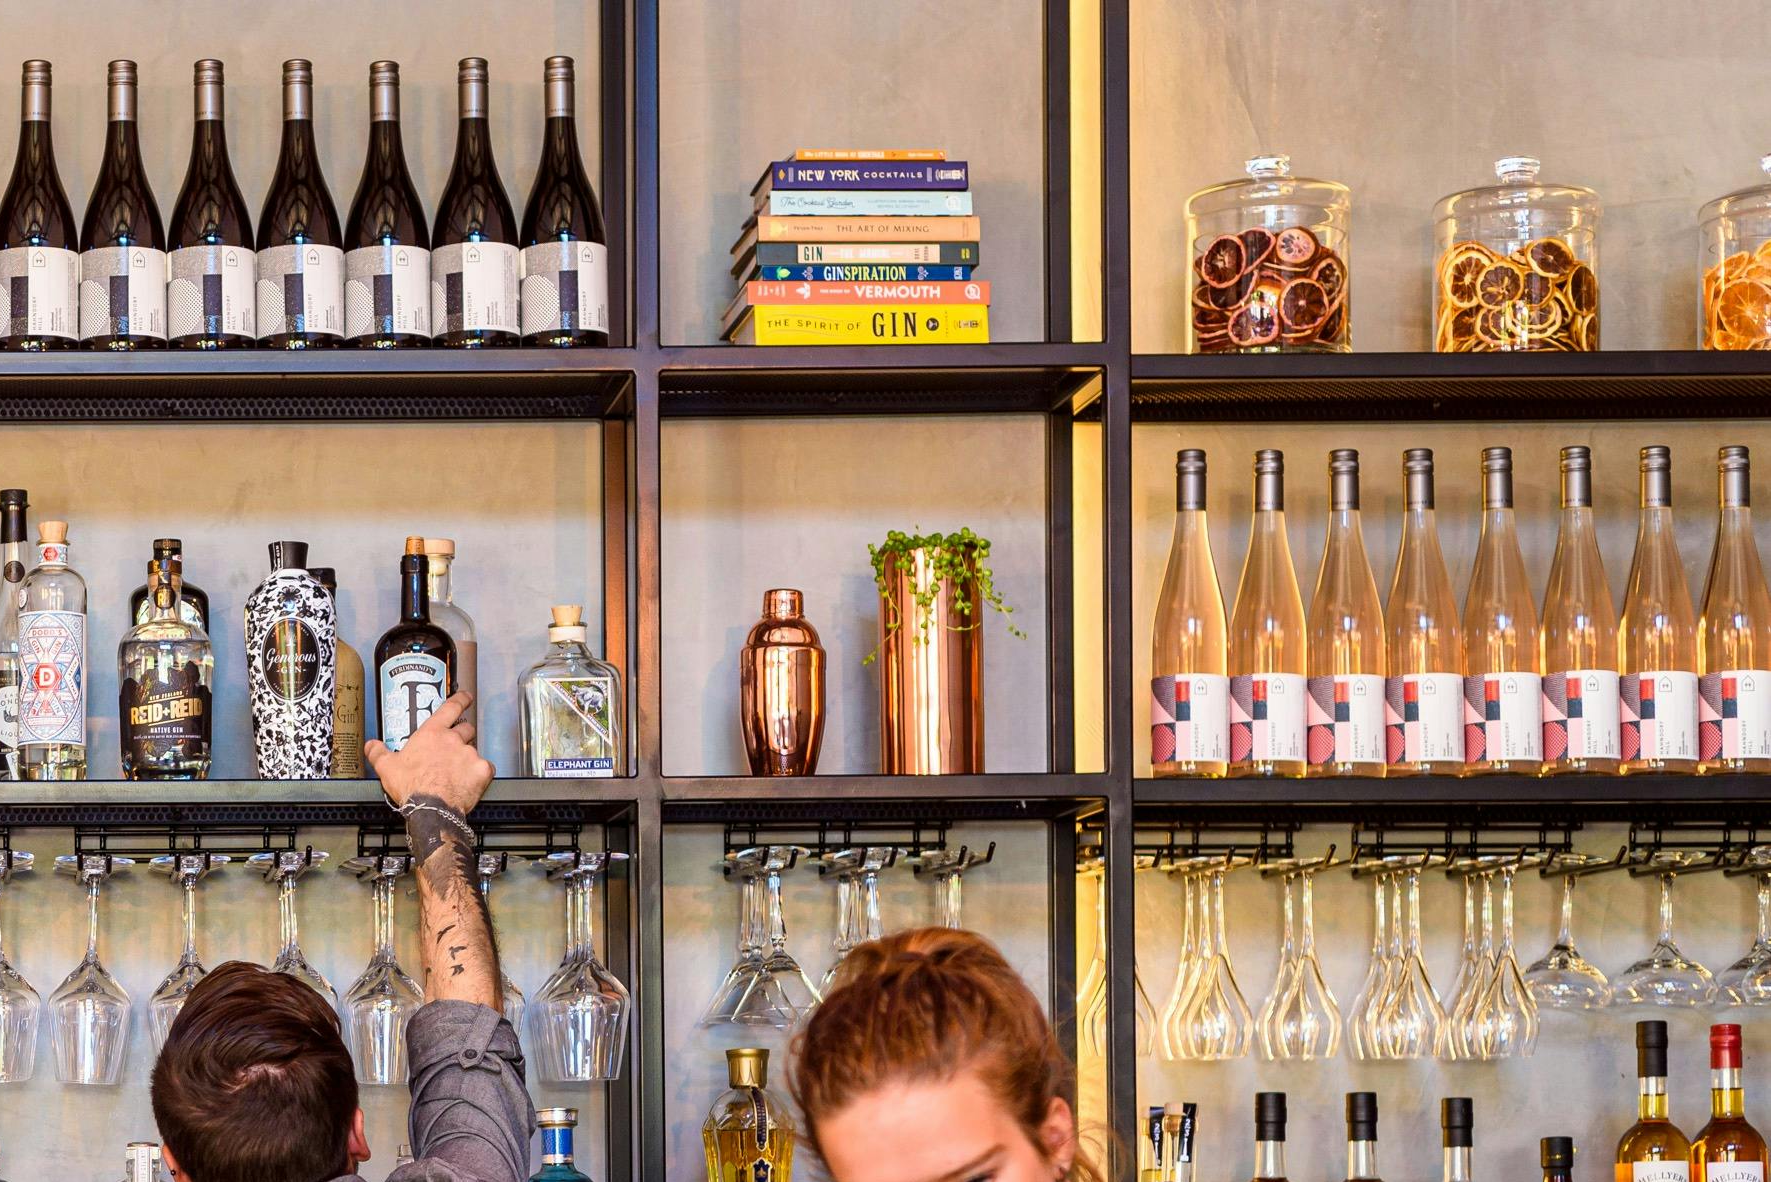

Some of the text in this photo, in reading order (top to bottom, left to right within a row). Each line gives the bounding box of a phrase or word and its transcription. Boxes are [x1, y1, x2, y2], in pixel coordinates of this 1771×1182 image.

[798, 170, 825, 181] NEW
[830, 170, 860, 181] YORK
[804, 246, 823, 261] GIN
[824, 266, 907, 281] GINSPIRATION
[854, 285, 941, 298] VERMOUTH
[767, 312, 916, 337] THE SPIRIT OF GIN
[31, 640, 41, 654] GIN
[266, 648, 316, 670] Generous
[39, 668, 56, 686] D
[131, 697, 202, 725] REID+REID
[337, 705, 355, 723] Gin
